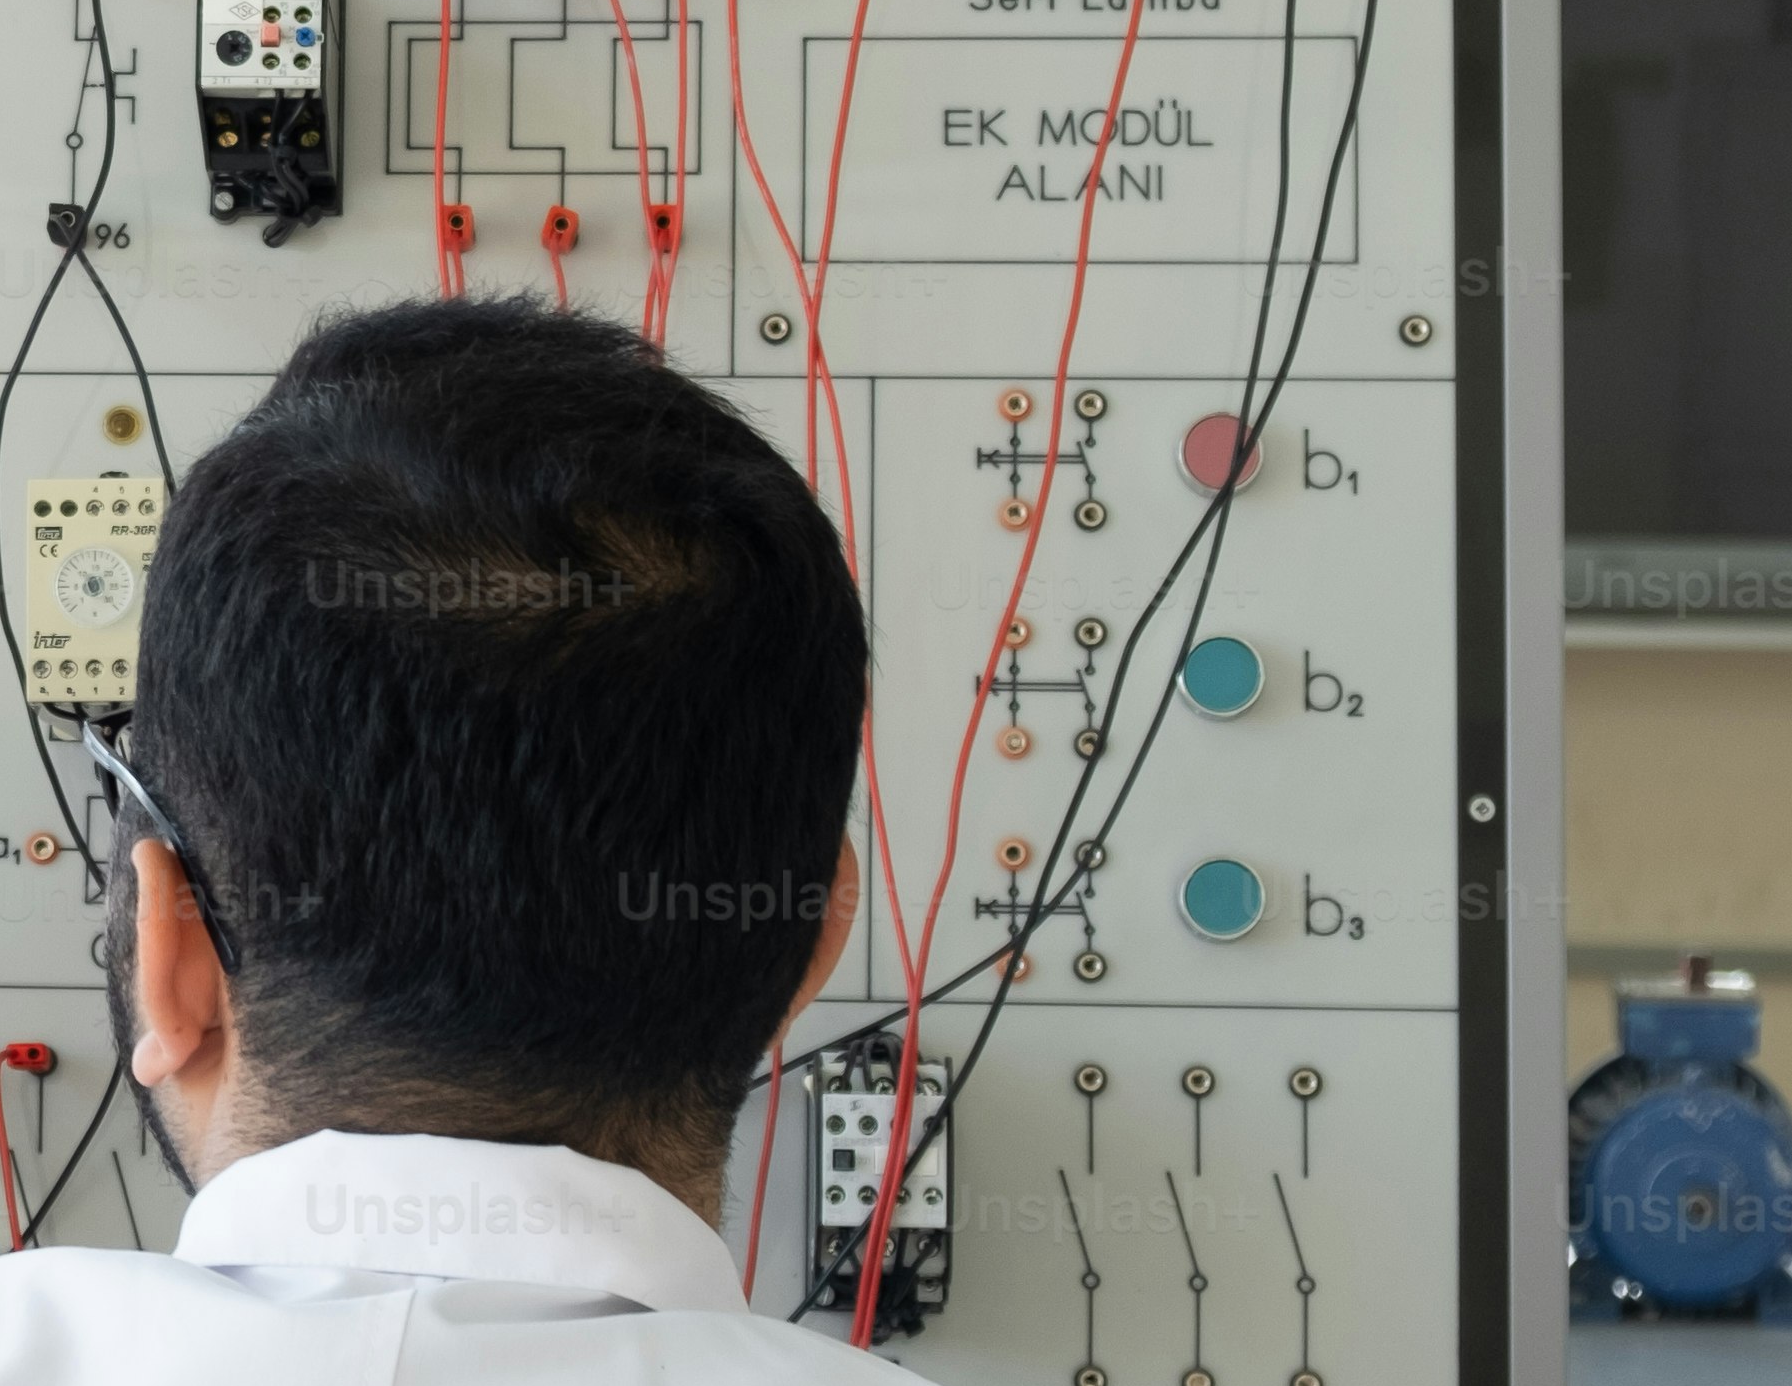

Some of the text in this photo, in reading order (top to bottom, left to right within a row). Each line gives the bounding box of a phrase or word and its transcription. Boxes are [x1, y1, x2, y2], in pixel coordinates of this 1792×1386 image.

[944, 98, 1213, 147] EK MODÜL
[996, 165, 1164, 201] ALANI
[96, 223, 131, 249] 96
